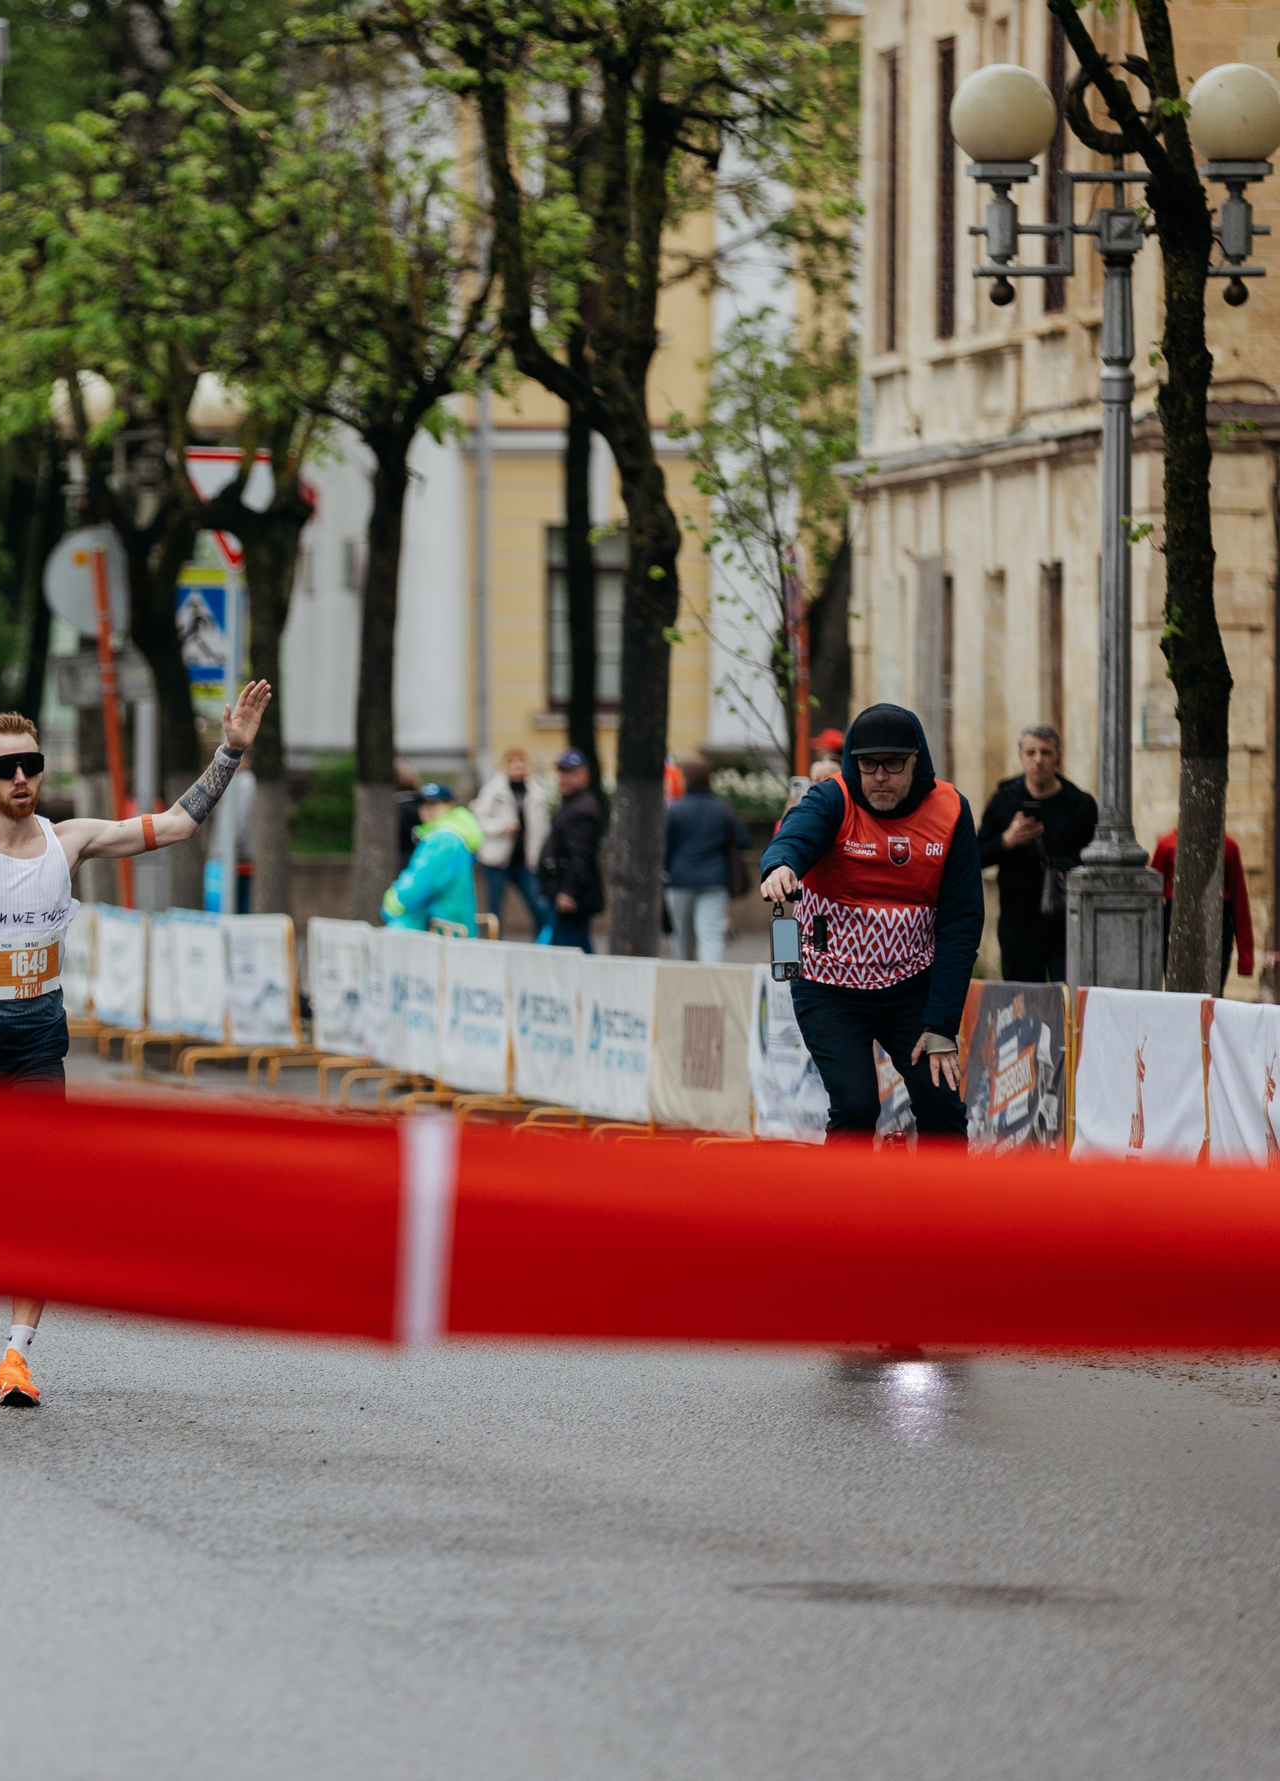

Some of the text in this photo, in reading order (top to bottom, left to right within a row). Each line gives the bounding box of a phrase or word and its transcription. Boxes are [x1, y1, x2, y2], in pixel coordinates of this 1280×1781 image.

[13, 912, 35, 923] WE
[10, 948, 48, 977] 1649
[993, 1053, 1033, 1109] ПЕРЕВОЗКИ
